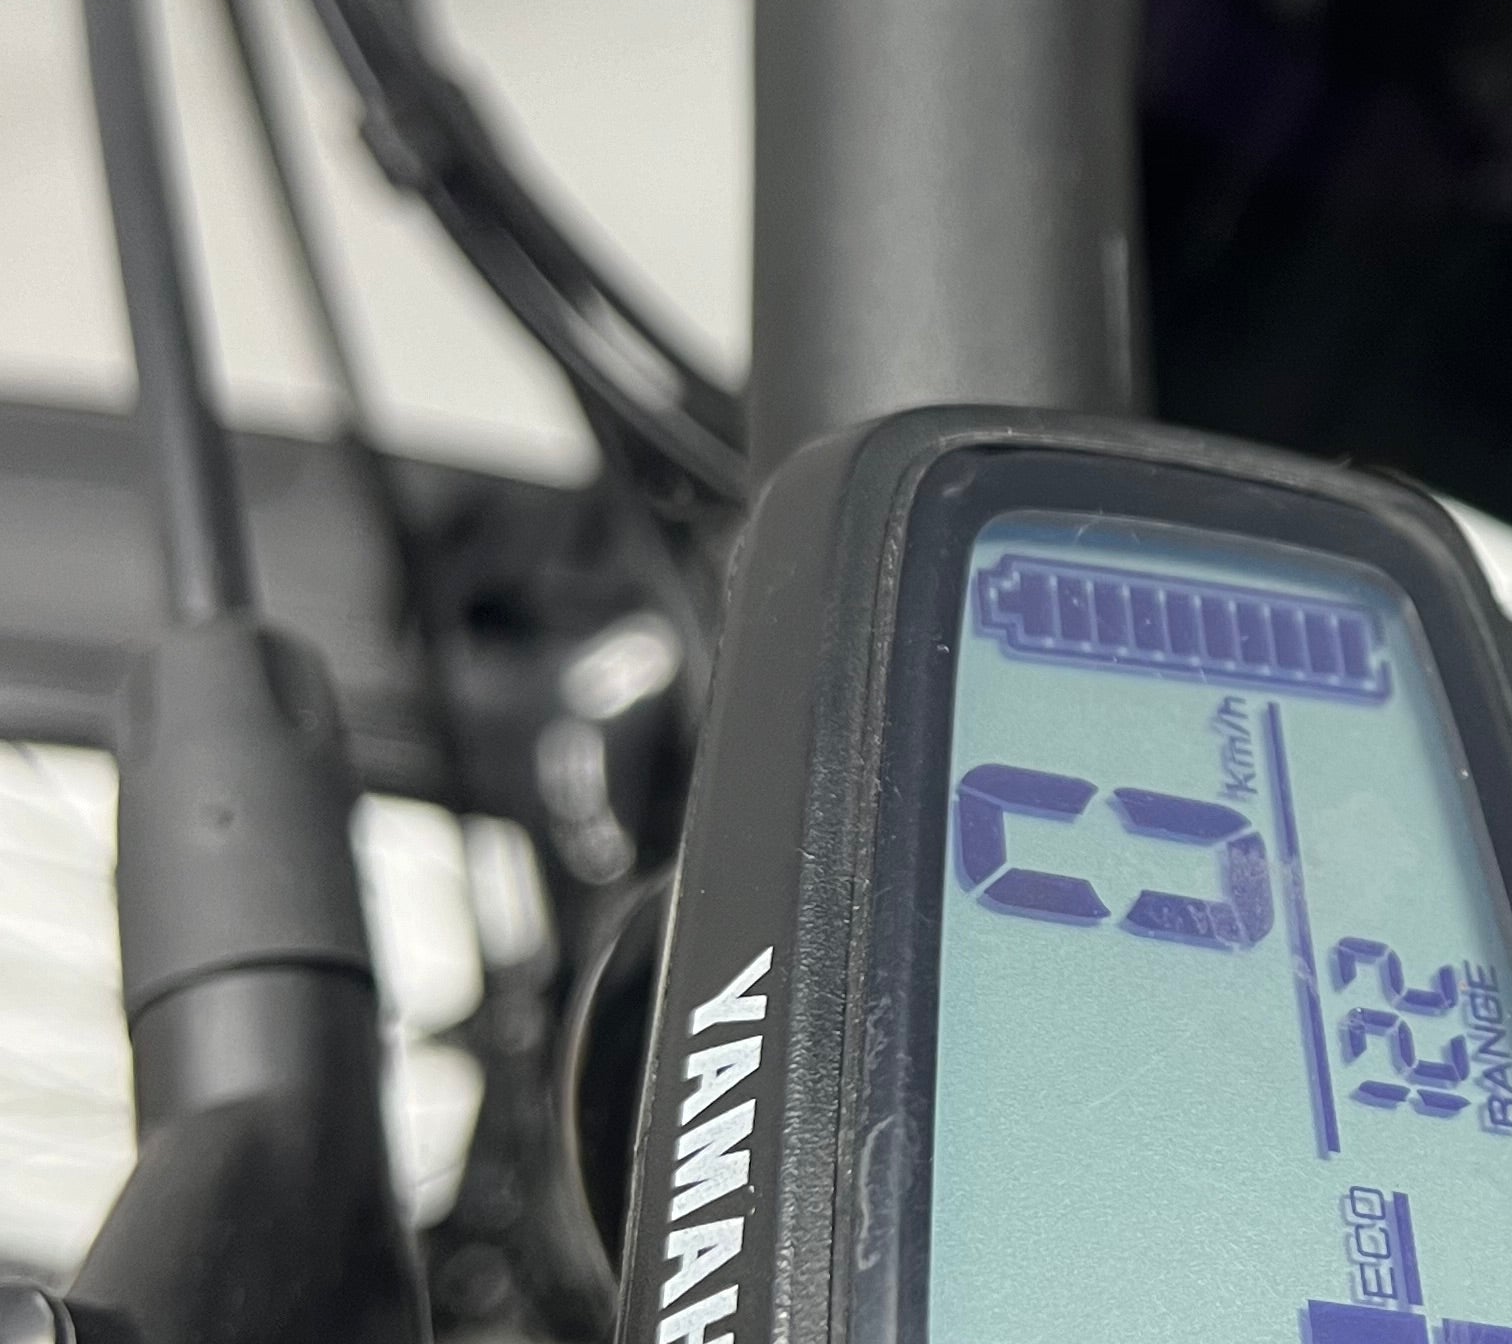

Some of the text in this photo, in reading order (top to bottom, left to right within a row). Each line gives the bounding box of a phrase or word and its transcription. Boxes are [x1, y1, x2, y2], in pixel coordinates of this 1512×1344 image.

[956, 762, 1275, 949] 0
[1336, 937, 1471, 1114] 122
[1347, 1185, 1398, 1301] ECO
